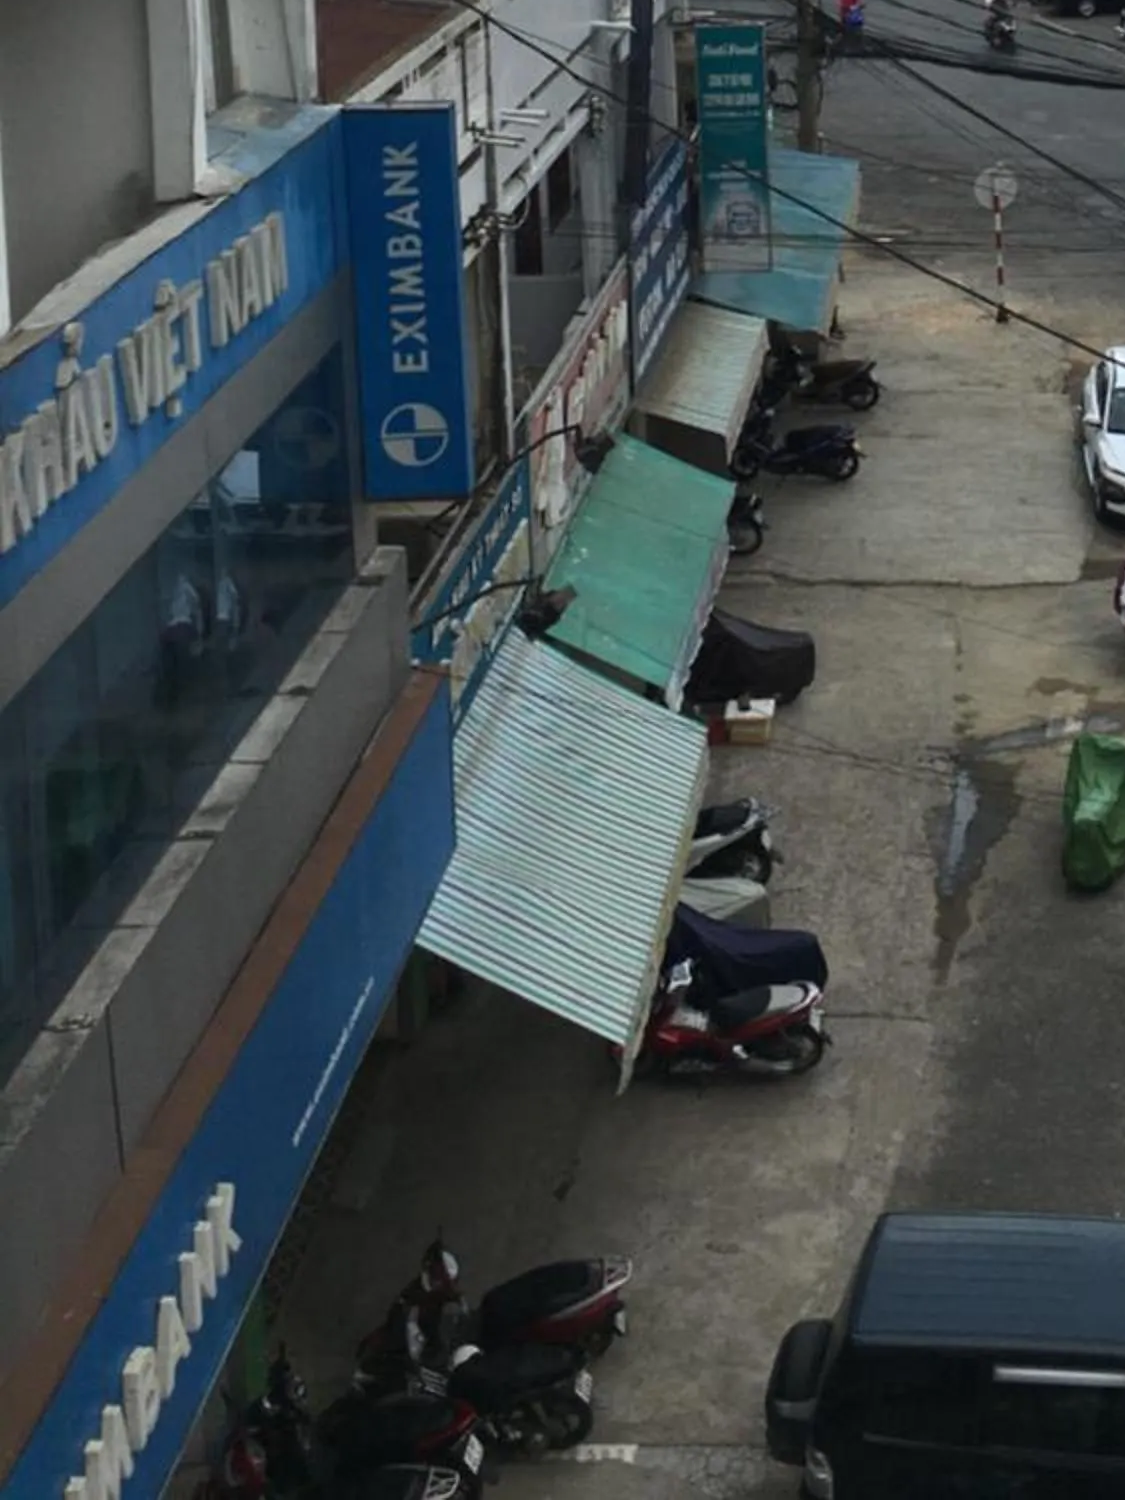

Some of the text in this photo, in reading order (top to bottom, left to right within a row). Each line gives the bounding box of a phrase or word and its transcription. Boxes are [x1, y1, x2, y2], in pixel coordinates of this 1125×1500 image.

[117, 278, 203, 425] VIỆT
[207, 212, 287, 348] NAM
[381, 140, 429, 374] EXIMBANK
[64, 1182, 243, 1500] MBANK
